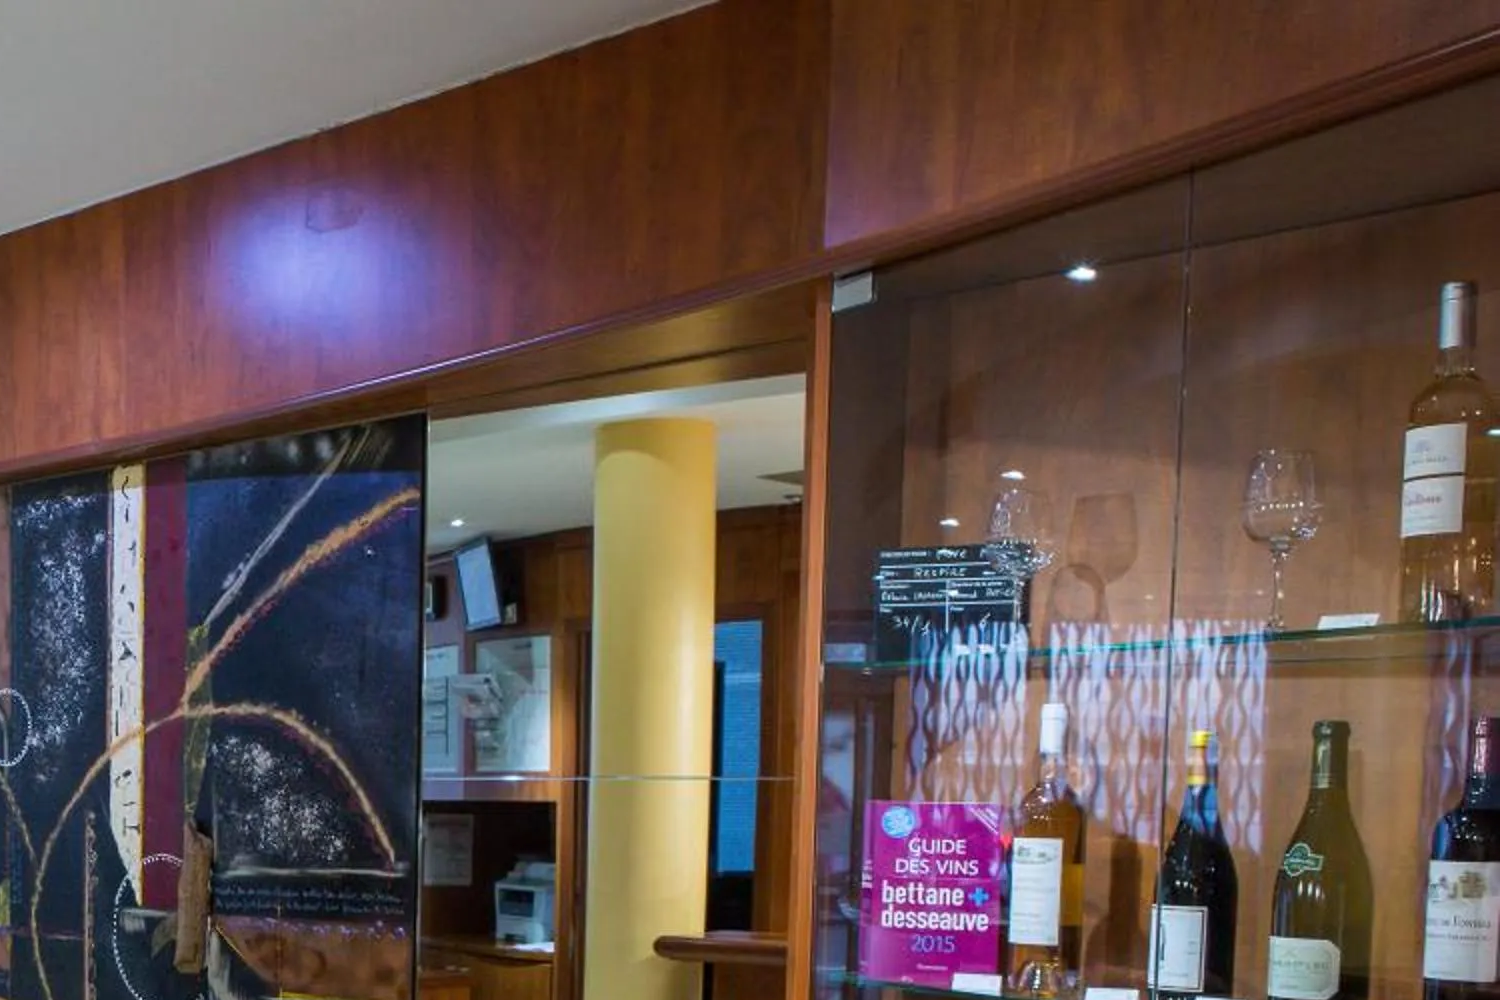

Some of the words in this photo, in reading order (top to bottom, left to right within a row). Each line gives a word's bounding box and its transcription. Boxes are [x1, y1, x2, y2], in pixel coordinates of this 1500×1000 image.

[908, 838, 967, 855] GUIDE
[895, 858, 930, 875] DES
[936, 859, 979, 876] VINS
[882, 879, 965, 906] bettane
[881, 905, 990, 932] desseauve
[910, 934, 955, 953] 2015
